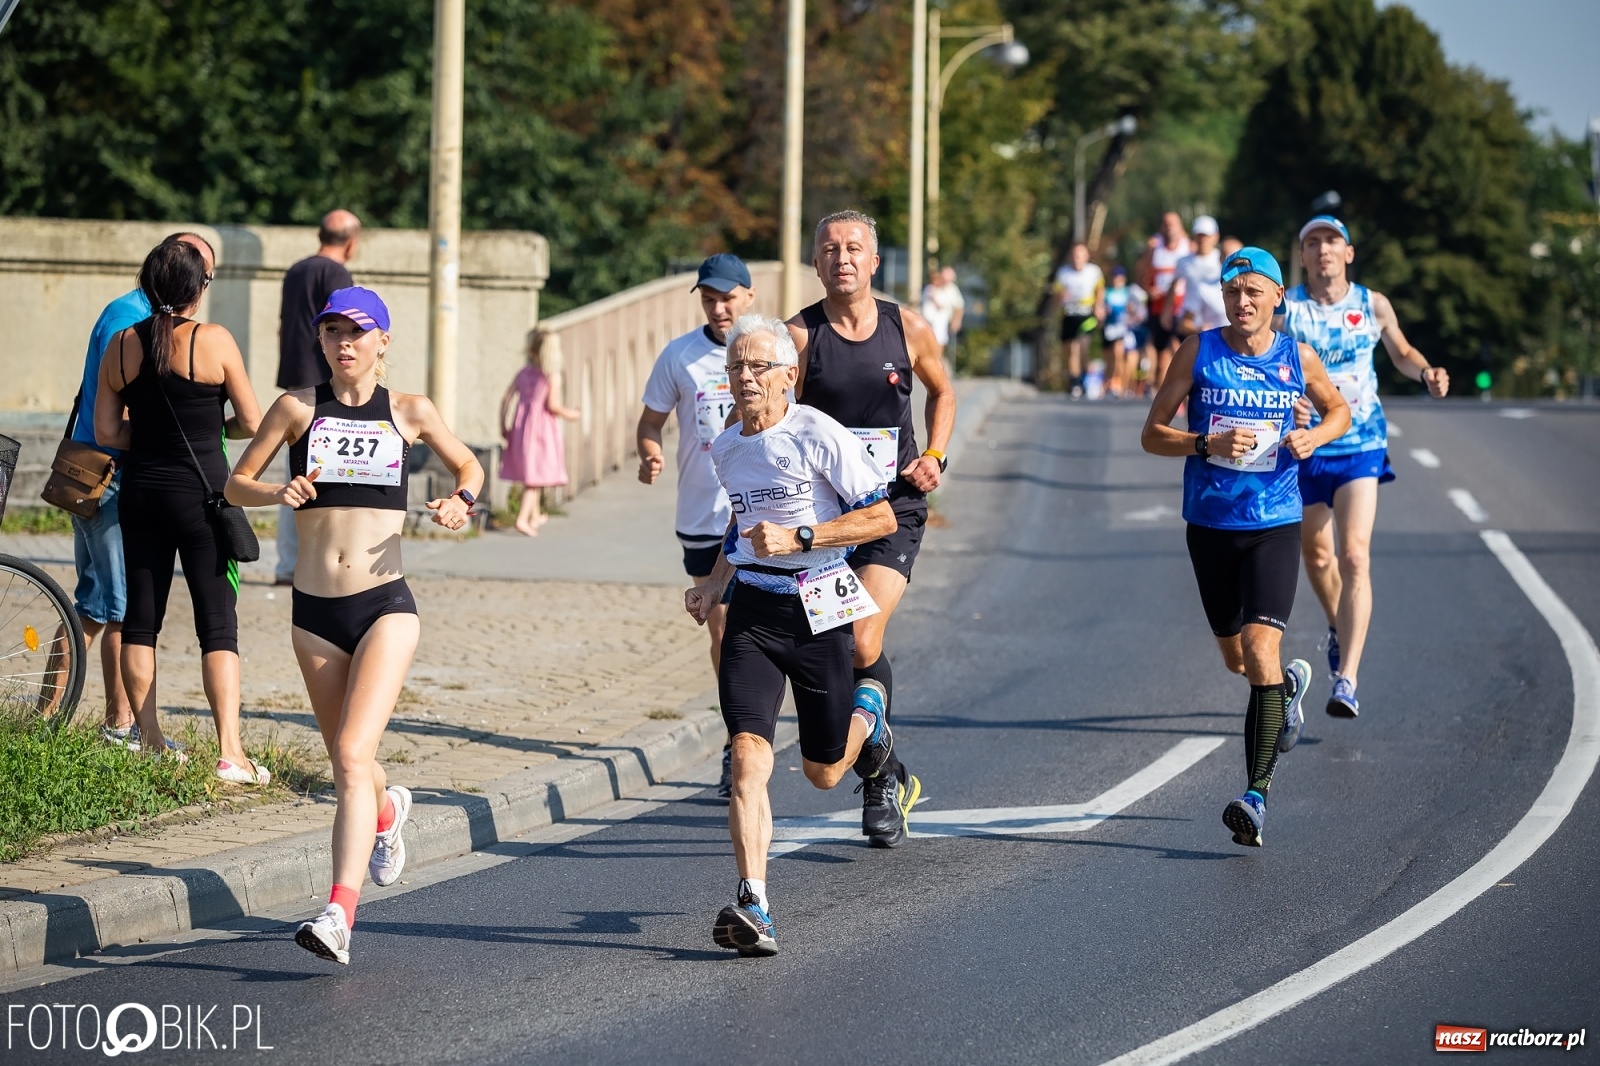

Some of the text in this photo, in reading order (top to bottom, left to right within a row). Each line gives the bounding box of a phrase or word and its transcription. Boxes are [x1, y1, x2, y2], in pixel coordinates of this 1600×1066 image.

[1200, 387, 1301, 408] RUNNERS
[337, 436, 379, 458] 257
[728, 480, 812, 514] BIERBUD
[835, 573, 859, 598] 63
